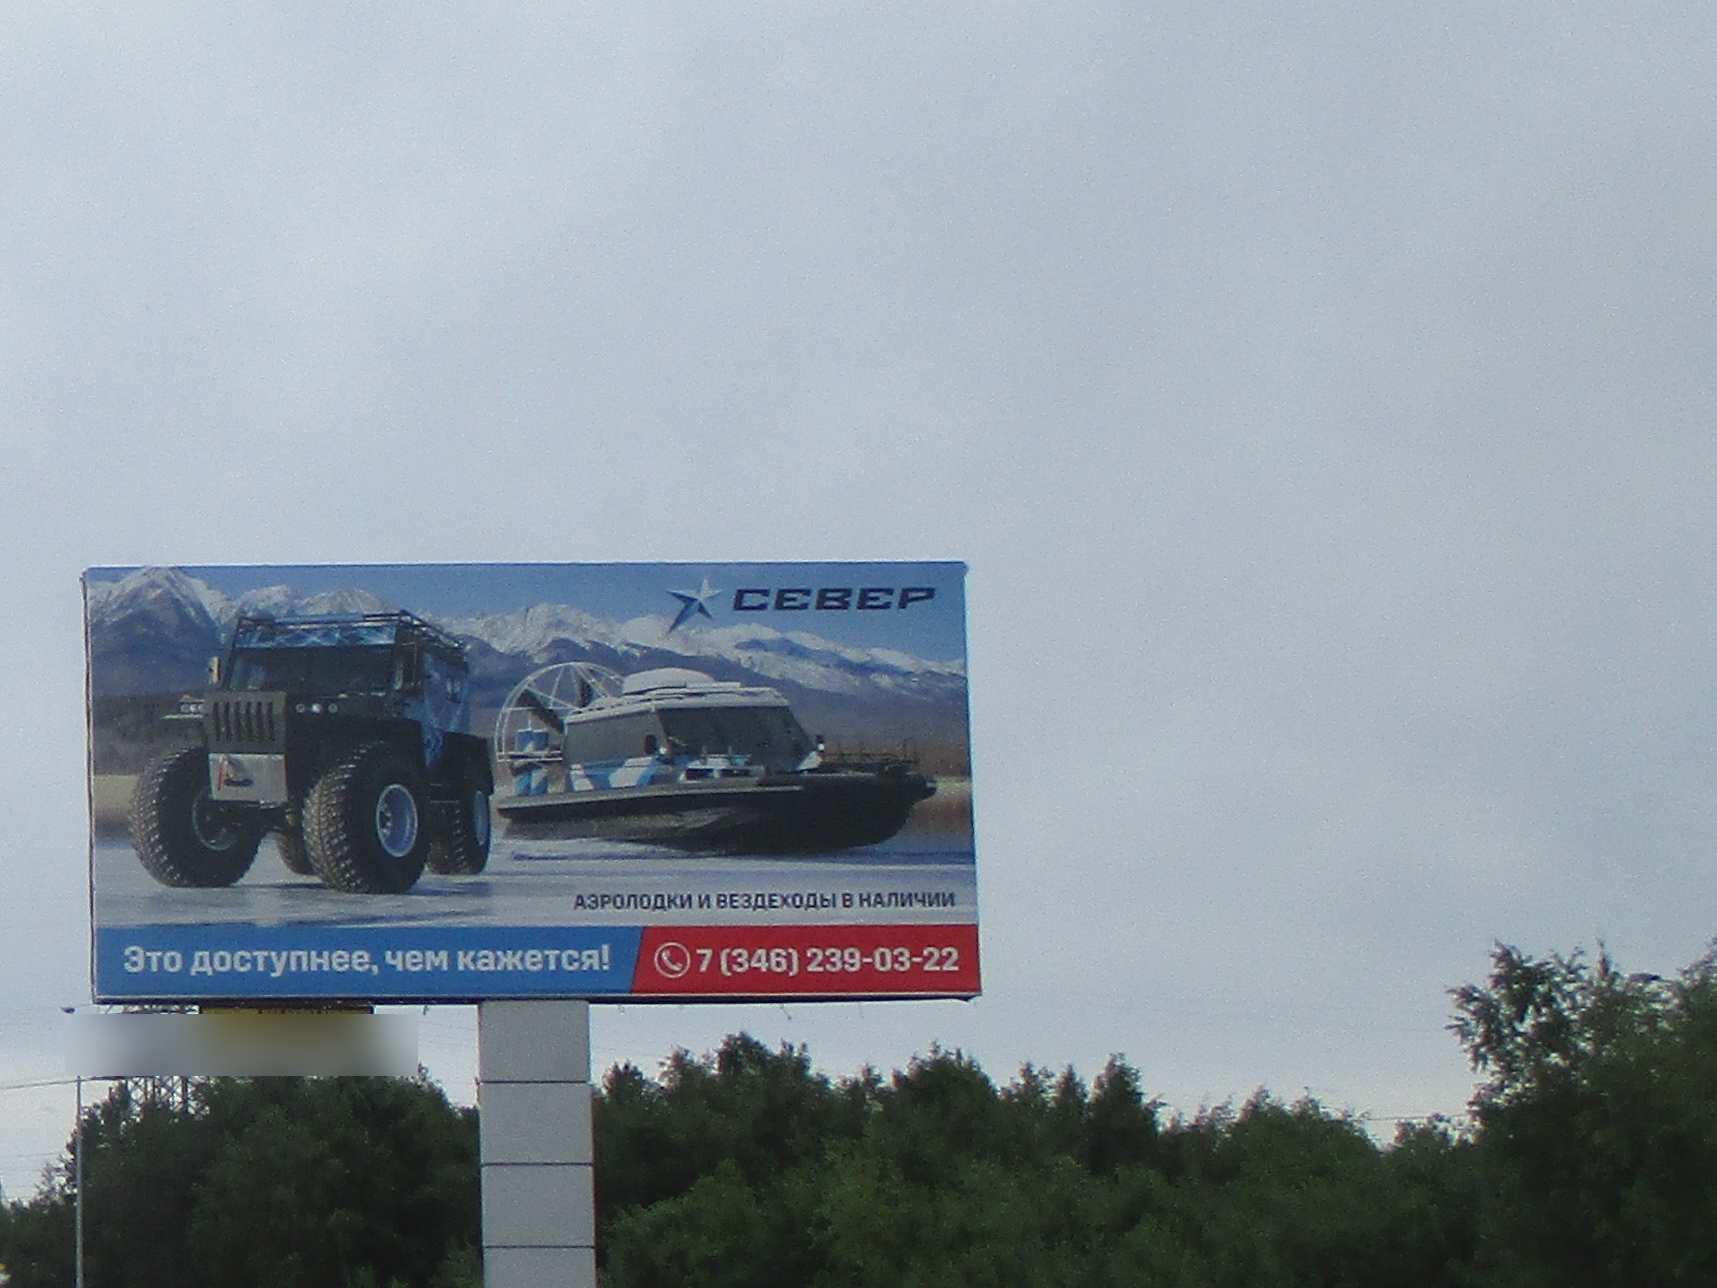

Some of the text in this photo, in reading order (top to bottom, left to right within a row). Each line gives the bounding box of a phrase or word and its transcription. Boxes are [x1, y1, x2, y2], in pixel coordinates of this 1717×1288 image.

[733, 587, 935, 611] СЕВЕР
[574, 891, 956, 911] АЭРОЛОДКИ И ВЕЗДЕХОДЫ В НАЛИЧИИ
[124, 944, 611, 977] Это доступнее, чем кажется!
[696, 946, 959, 976] 7 (346) 239-03-22
